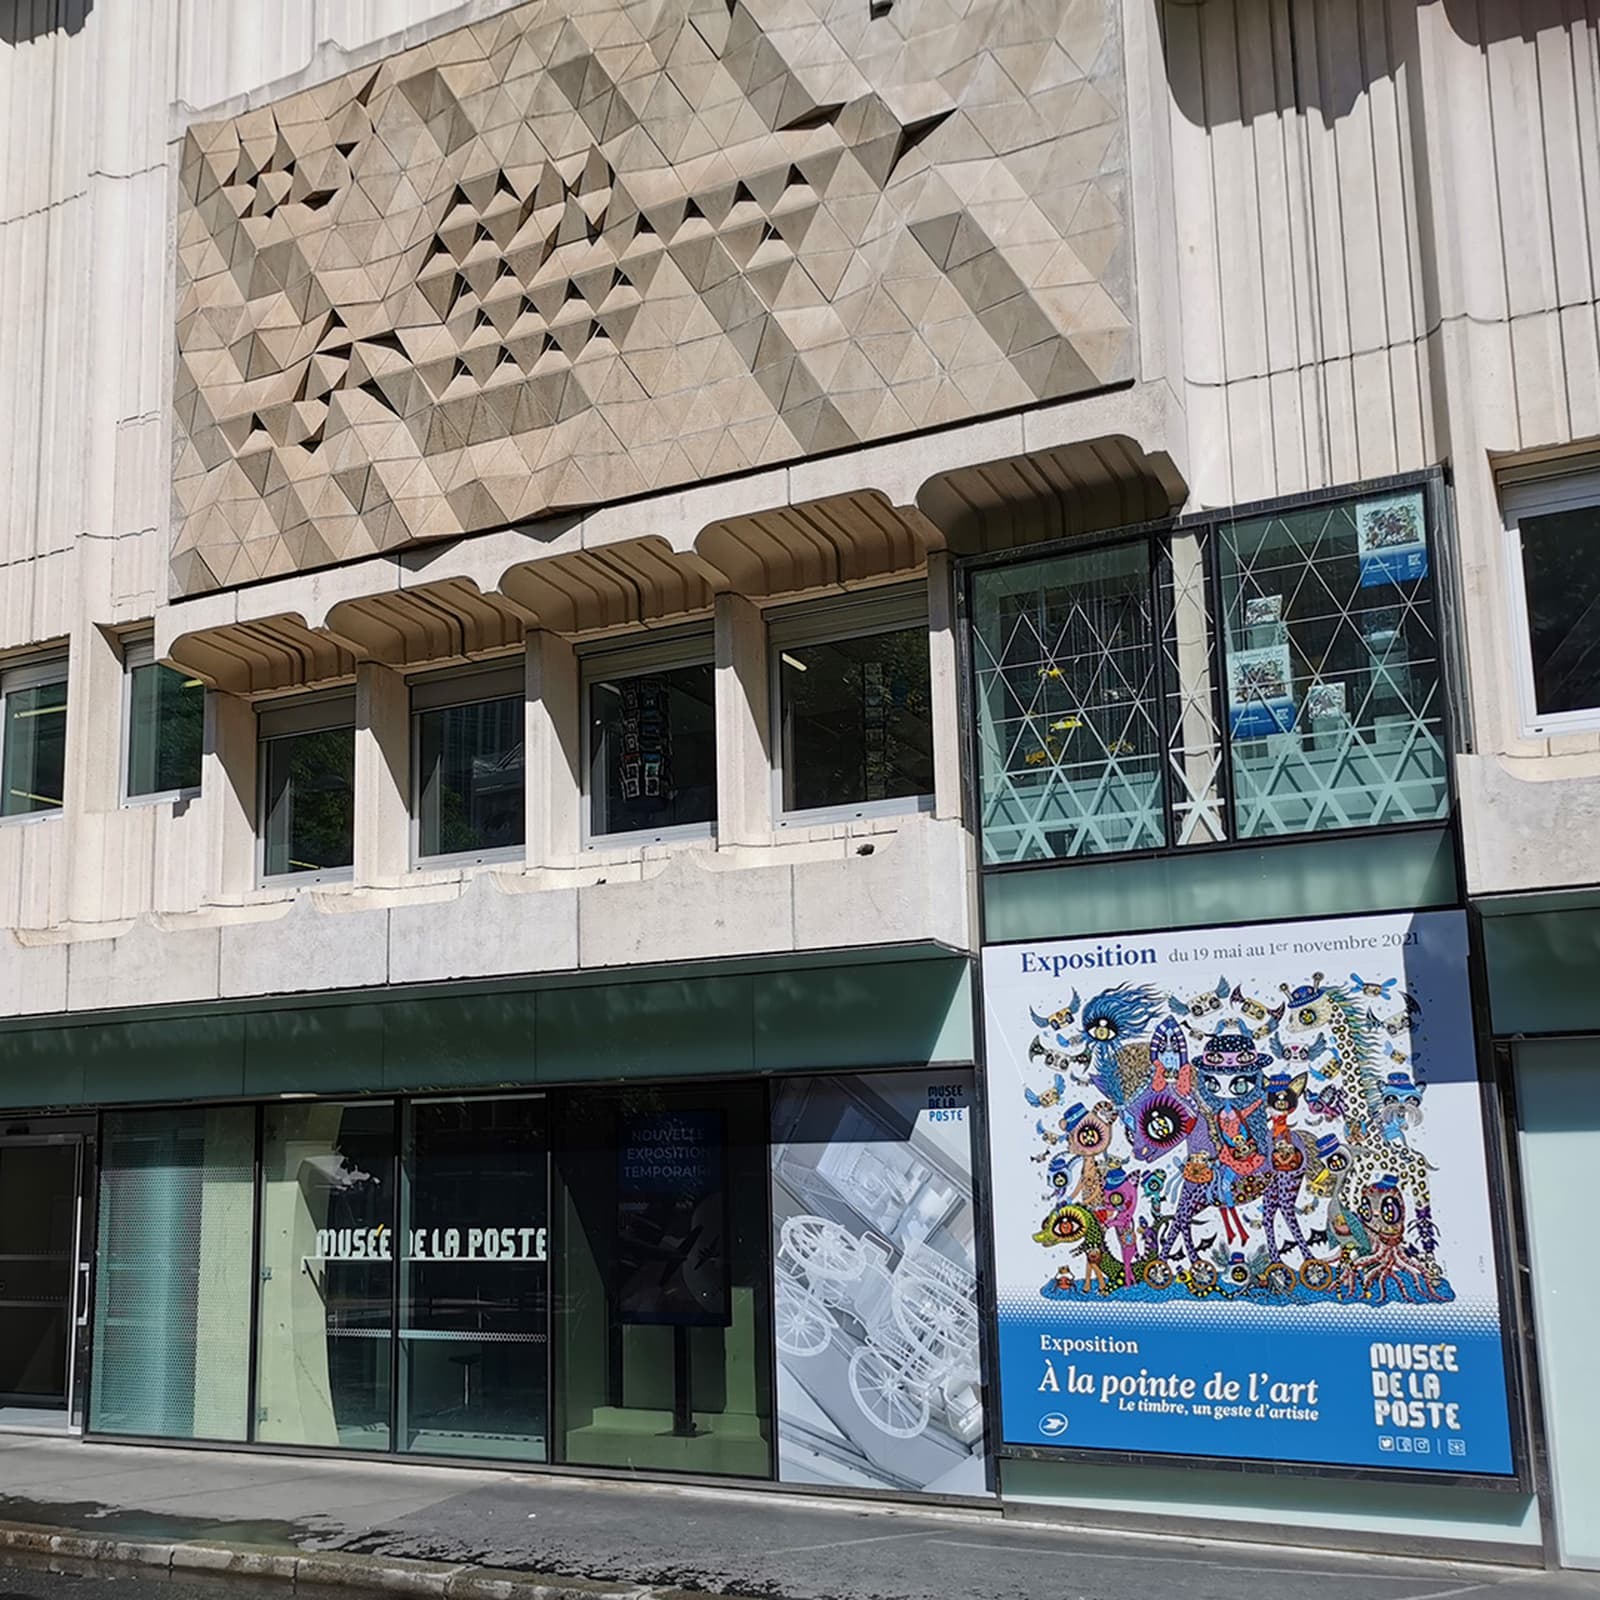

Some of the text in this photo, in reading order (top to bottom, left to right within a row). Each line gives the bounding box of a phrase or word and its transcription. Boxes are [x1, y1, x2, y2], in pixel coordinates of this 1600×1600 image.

[1021, 932, 1418, 977] Exposition du 19 mai au 1er novembre 2021
[929, 1110, 963, 1122] POSTE
[316, 1224, 547, 1257] MUSÉE E LA POSTE
[1040, 1334, 1139, 1356] Exposition
[1370, 1343, 1459, 1372] MUSÉE
[1038, 1359, 1319, 1405] À la pointe de l’art
[1372, 1371, 1441, 1400] DE LA
[1118, 1398, 1319, 1421] Le timbre, un geste d’artiste
[1374, 1400, 1461, 1430] POSTE
